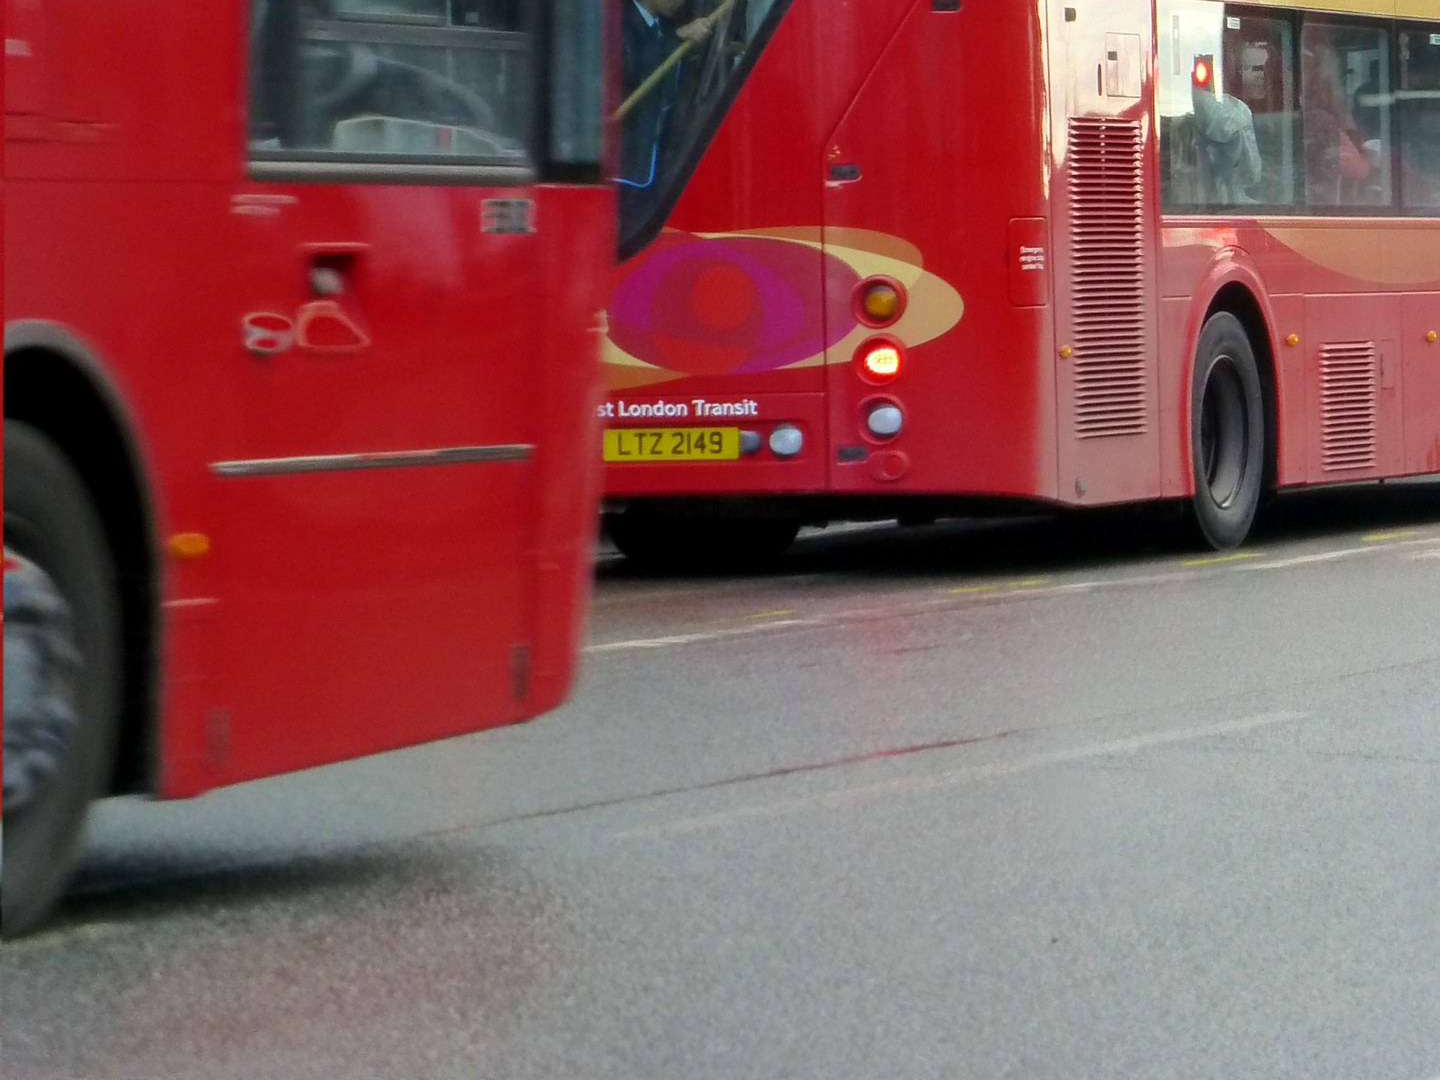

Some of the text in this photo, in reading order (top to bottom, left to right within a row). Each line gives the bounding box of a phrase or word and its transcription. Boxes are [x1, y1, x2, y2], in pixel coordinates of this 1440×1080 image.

[596, 399, 758, 417] st London Transit
[618, 431, 723, 456] LTZ 2149
